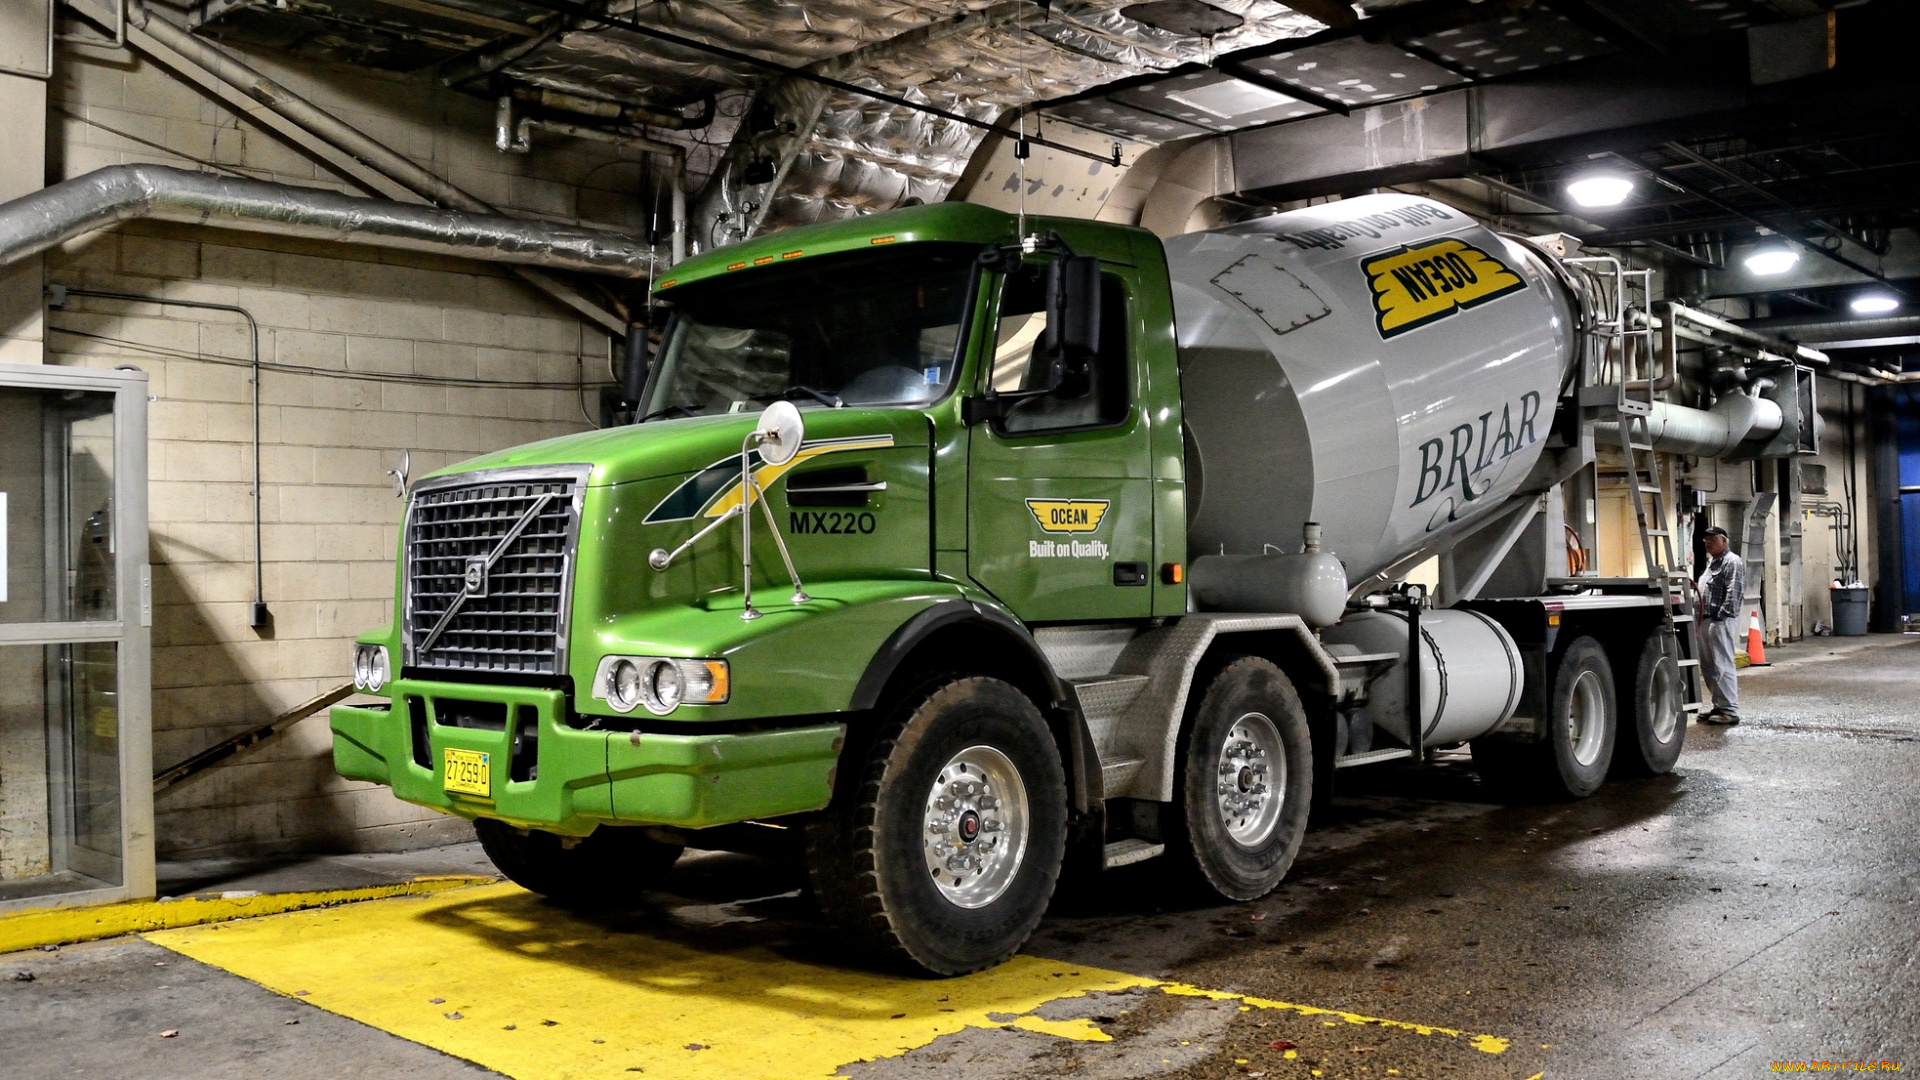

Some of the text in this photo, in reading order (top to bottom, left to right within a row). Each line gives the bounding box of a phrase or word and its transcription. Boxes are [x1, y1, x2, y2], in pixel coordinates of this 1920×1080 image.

[1358, 214, 1401, 230] on
[1384, 203, 1454, 227] Built
[1391, 252, 1479, 304] OCEAN
[1409, 390, 1541, 510] BRIAR
[1051, 508, 1088, 525] OCEAN
[1029, 540, 1109, 561] Built on Quality.
